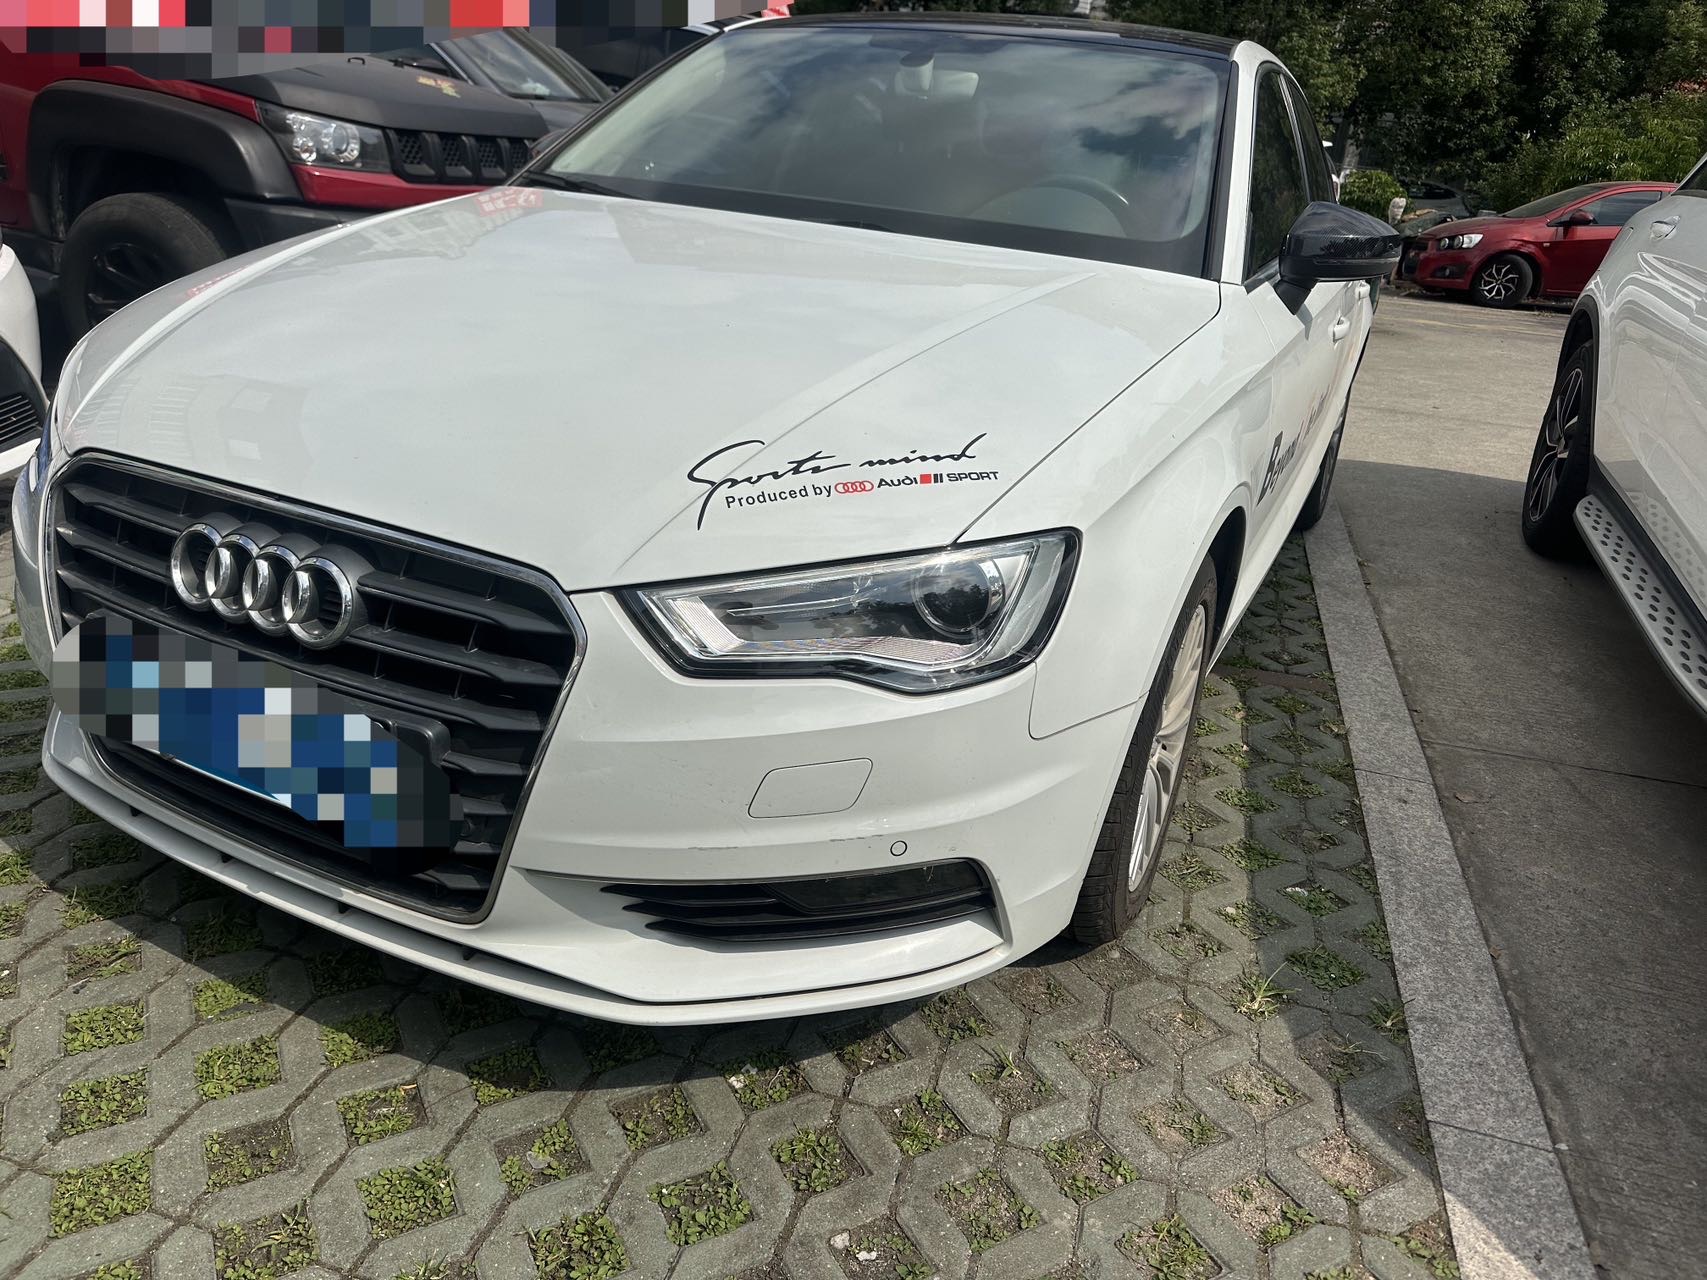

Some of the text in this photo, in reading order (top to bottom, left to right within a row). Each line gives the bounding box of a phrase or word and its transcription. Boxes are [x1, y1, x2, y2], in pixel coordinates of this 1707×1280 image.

[859, 432, 987, 468] mind
[725, 470, 999, 509] Produced by Audi SPORT
